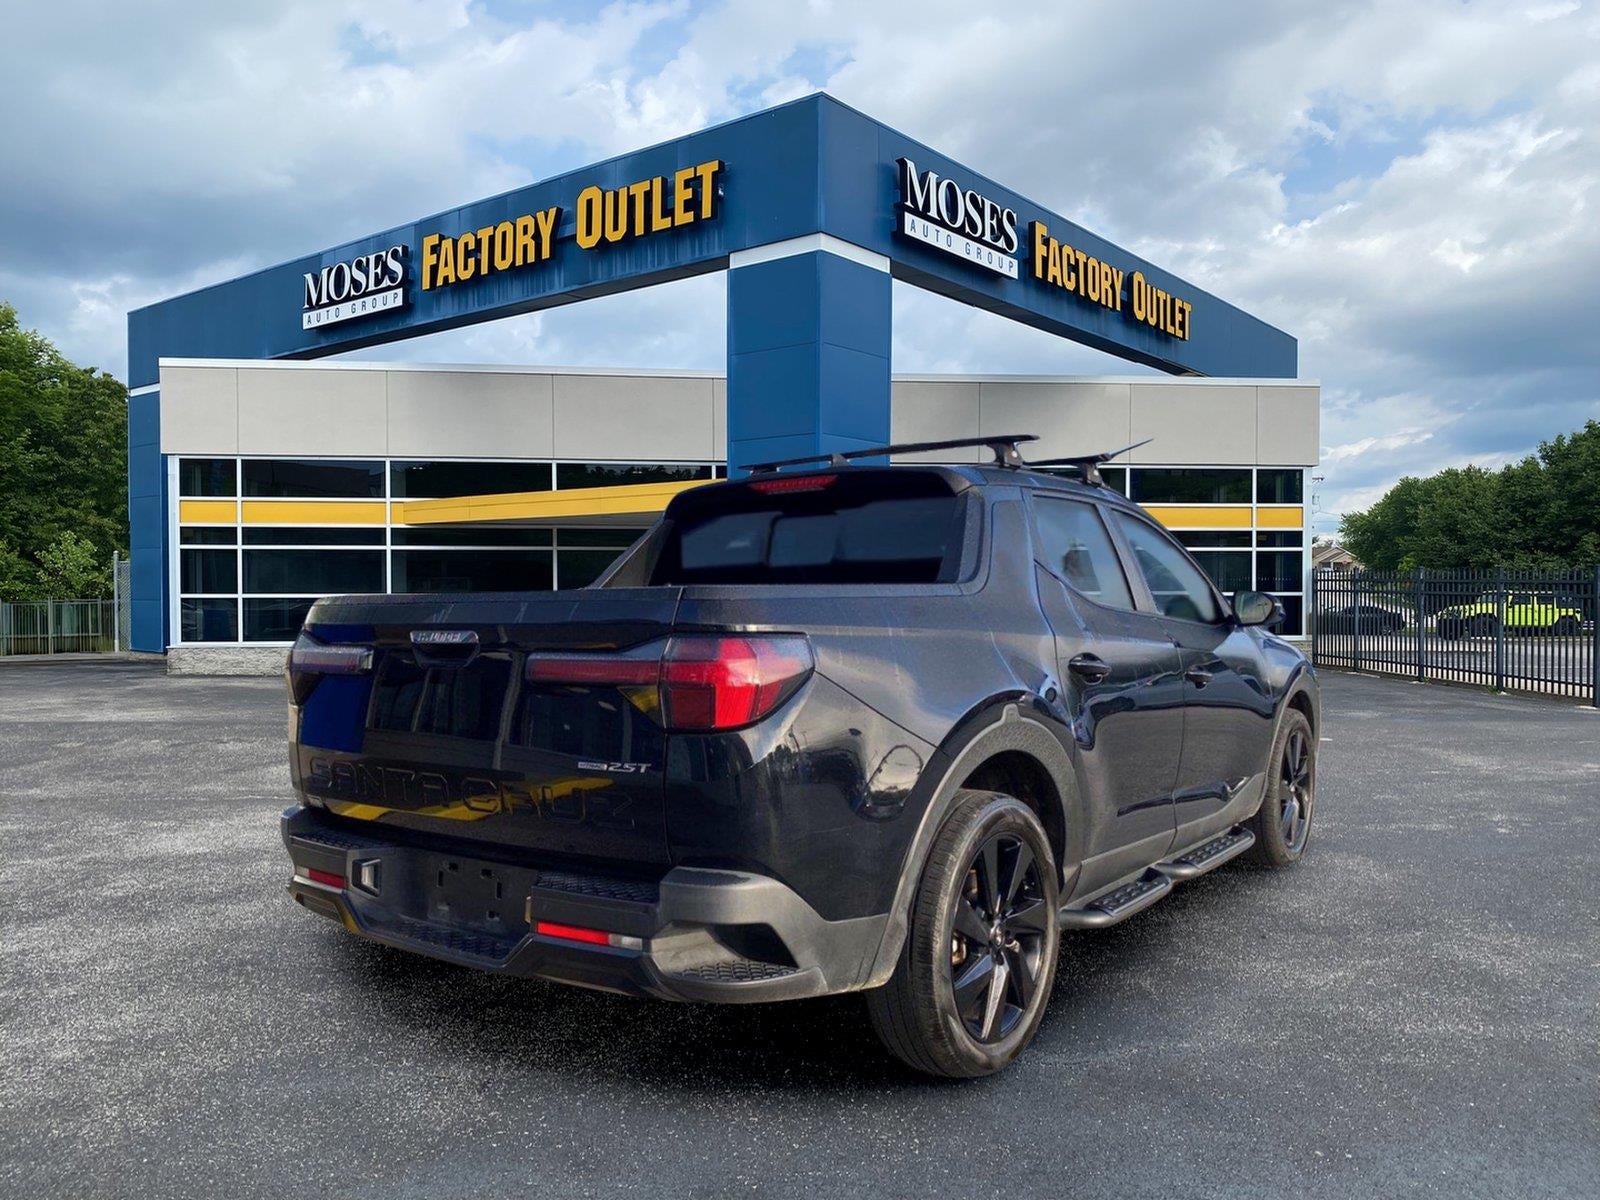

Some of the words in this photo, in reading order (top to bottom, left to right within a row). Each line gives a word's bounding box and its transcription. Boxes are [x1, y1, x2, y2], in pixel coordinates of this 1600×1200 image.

[421, 206, 560, 290] FACTORY
[576, 159, 721, 249] OUTLET
[903, 157, 1018, 254] MOSES
[303, 246, 403, 309] MOSES
[909, 219, 953, 248] AUTO
[964, 238, 1014, 273] GROUP
[1034, 220, 1124, 311] FACTORY
[1132, 270, 1192, 341] OUTLET
[306, 307, 340, 325] AUTO
[350, 292, 399, 314] GROUP
